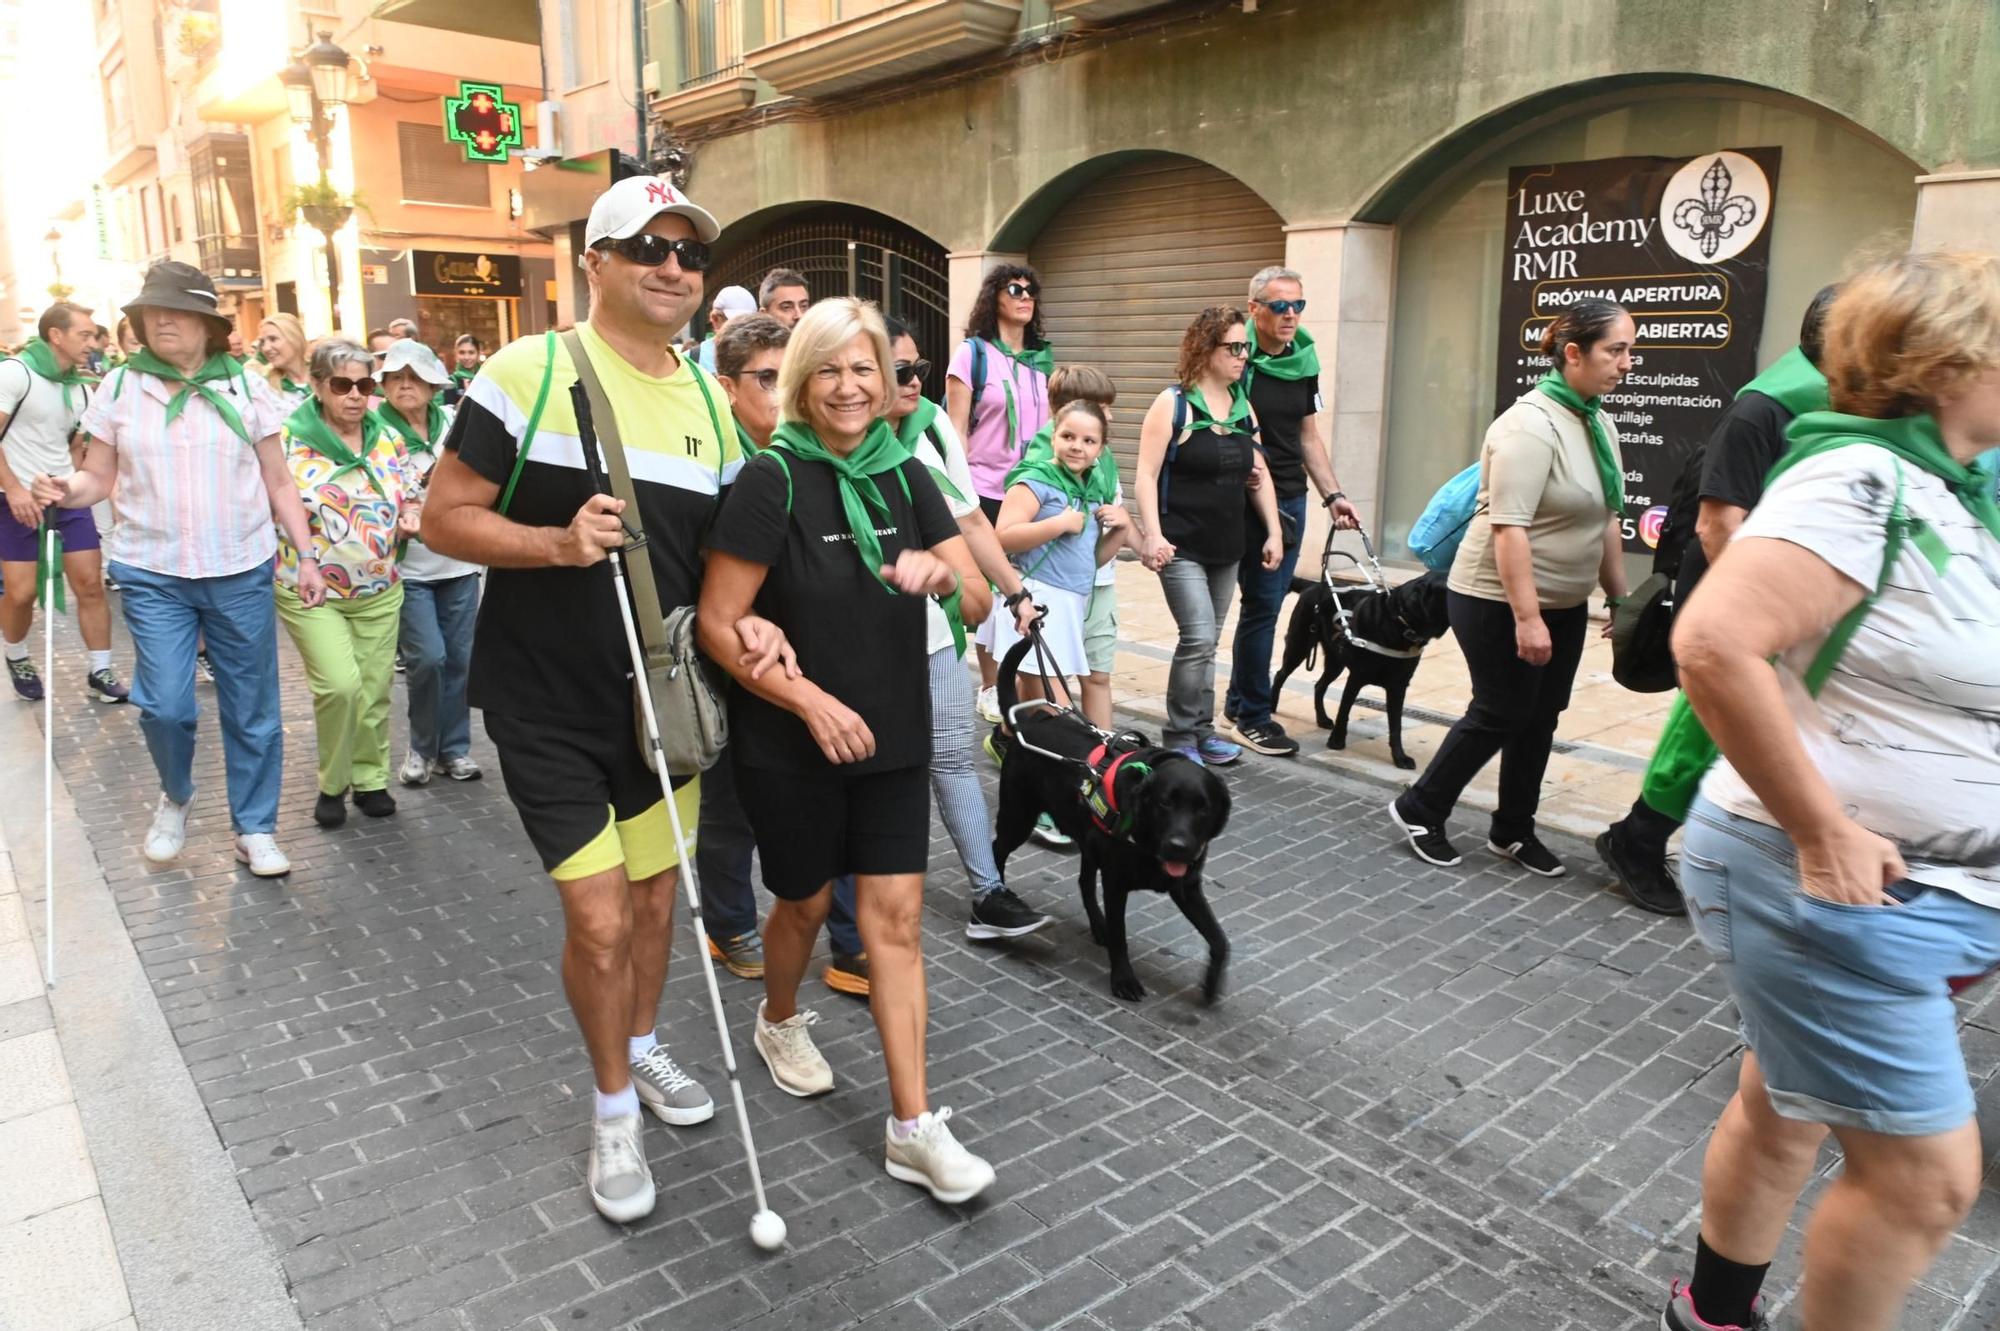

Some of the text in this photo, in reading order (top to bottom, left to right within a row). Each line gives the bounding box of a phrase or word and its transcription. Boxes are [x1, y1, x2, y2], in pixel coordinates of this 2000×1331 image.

[1518, 188, 1585, 216] Luxe
[1513, 212, 1656, 248] Academy
[1513, 250, 1578, 281] RMR
[1620, 285, 1722, 303] APERTURA
[1636, 323, 1729, 339] ABIERTAS
[1626, 373, 1699, 387] Esculpidas
[1599, 391, 1721, 409] icropigmentación
[822, 534, 840, 543] YOU
